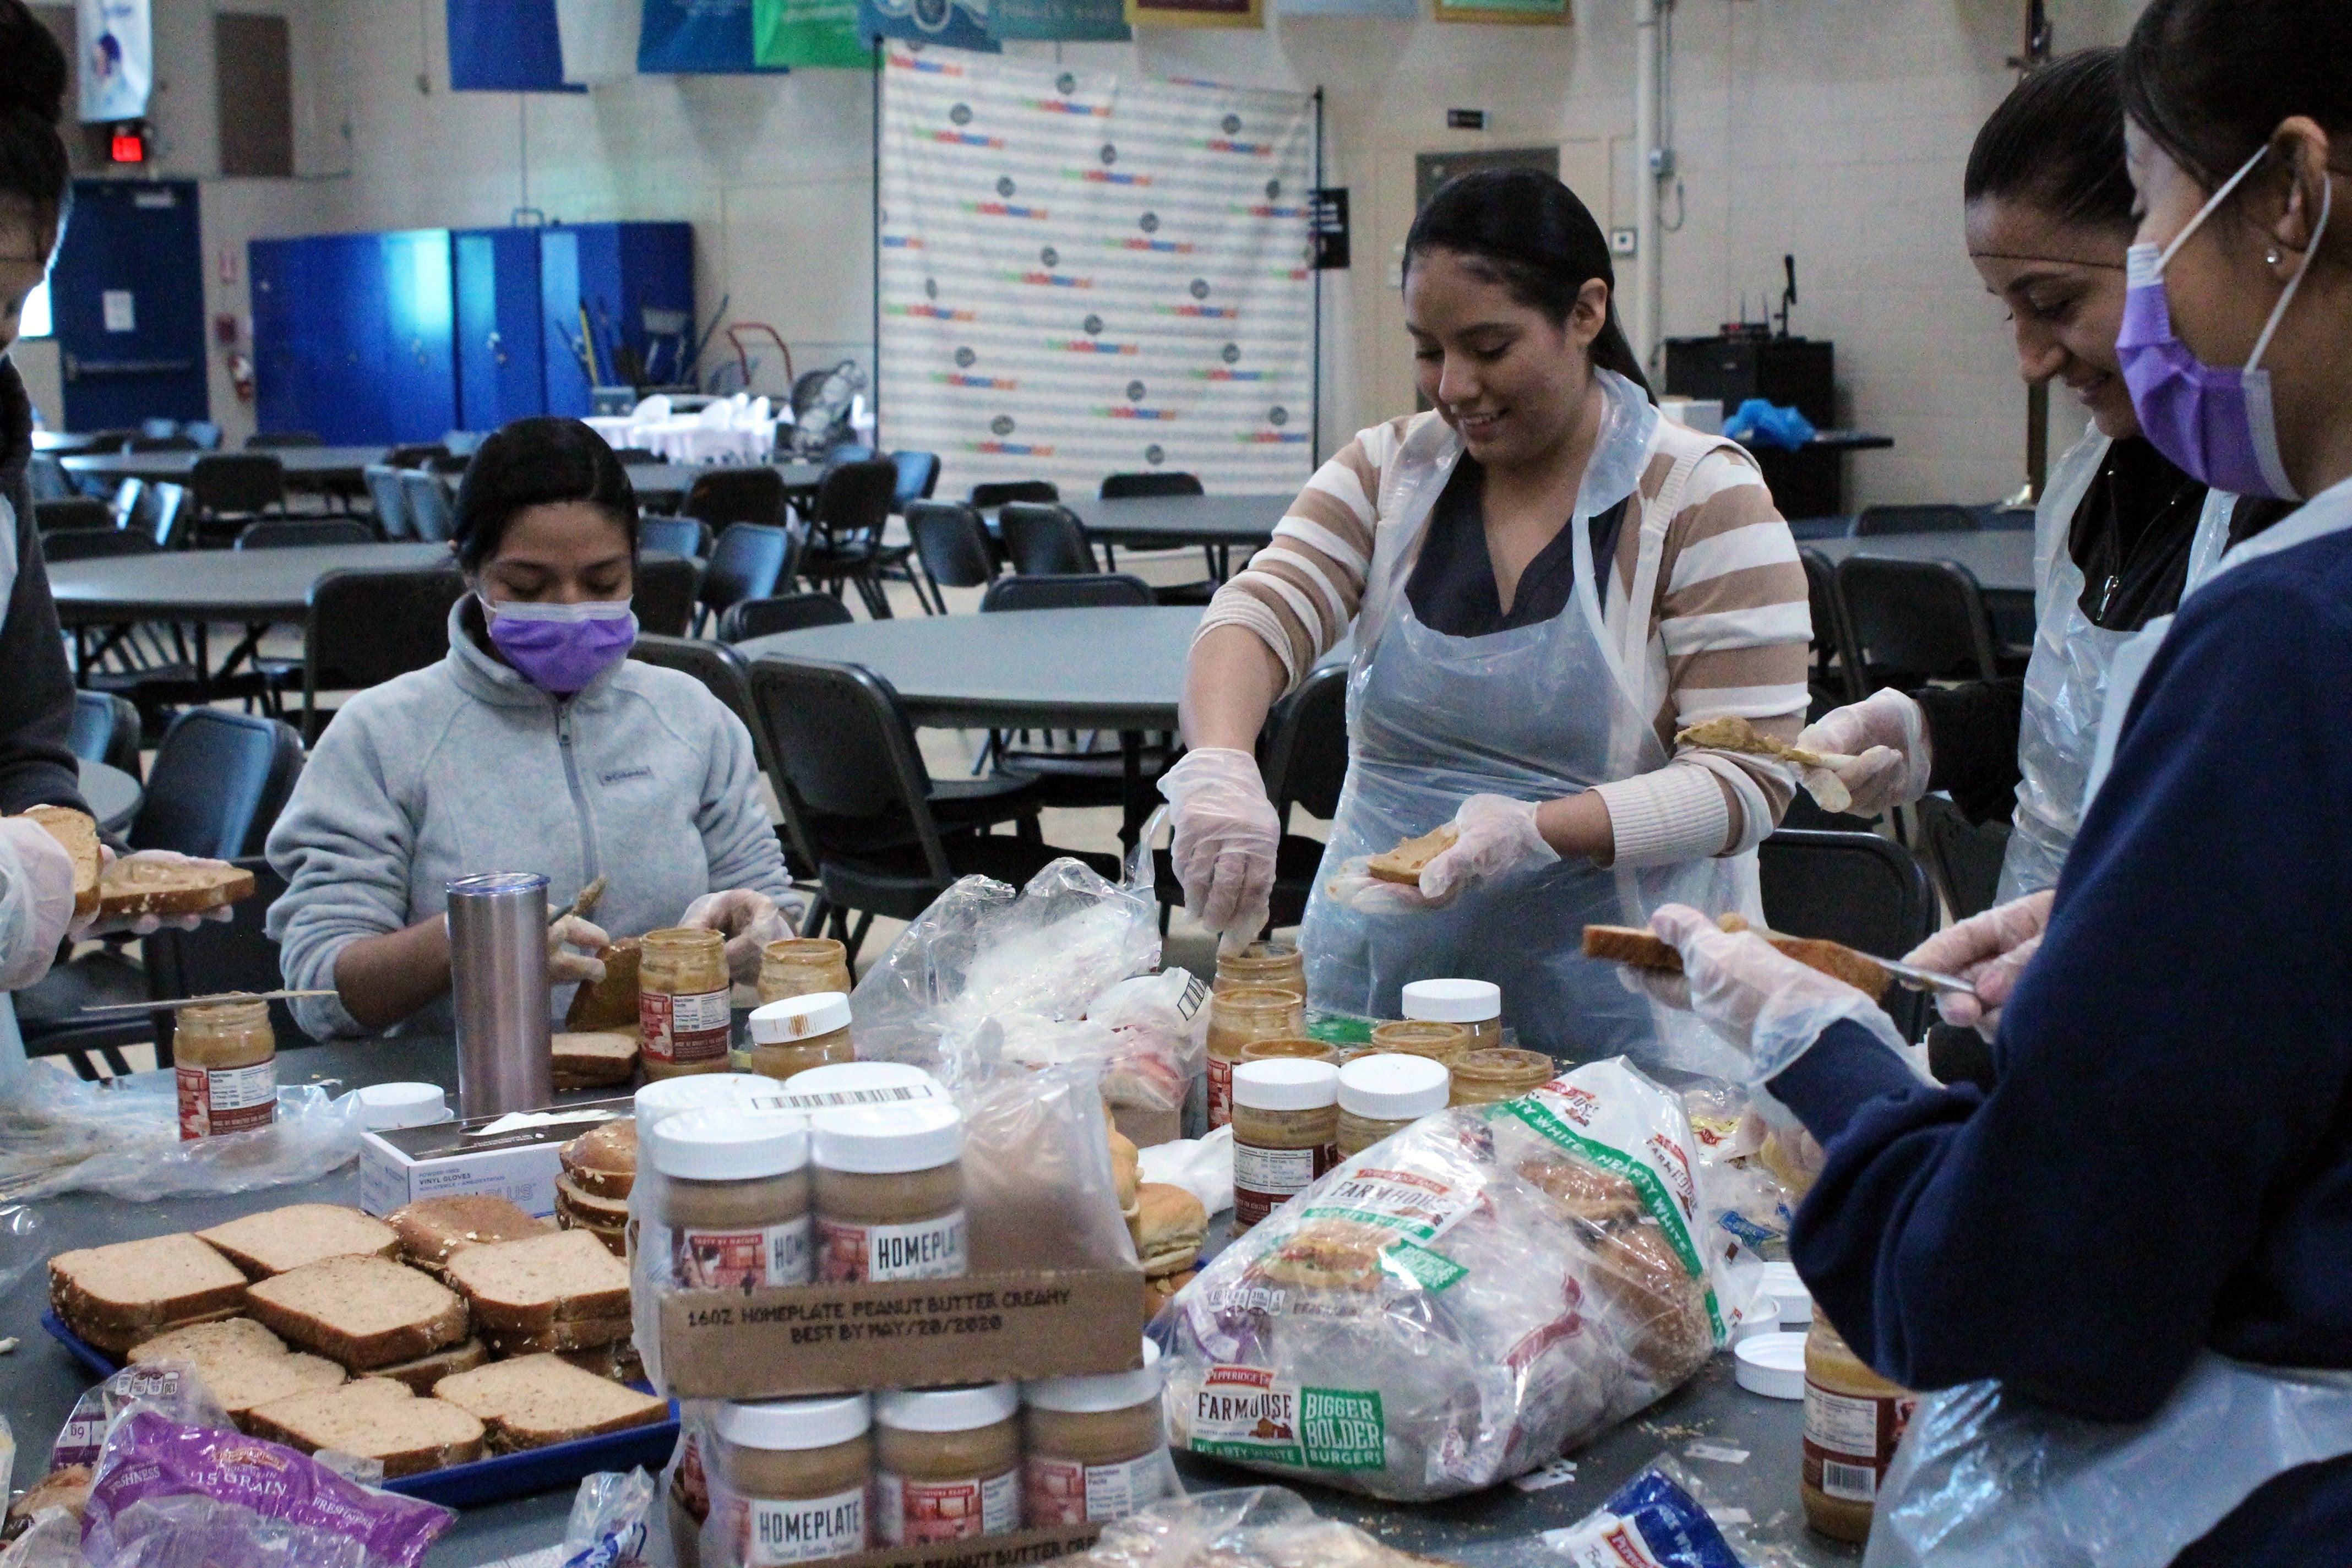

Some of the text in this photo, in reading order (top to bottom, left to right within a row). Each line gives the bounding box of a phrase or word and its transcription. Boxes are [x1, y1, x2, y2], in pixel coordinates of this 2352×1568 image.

[419, 1172, 472, 1185] VINYL GLOVES
[742, 1302, 845, 1323] HOMEPLATE
[852, 1297, 923, 1317] PEANUT
[927, 1292, 998, 1314] BUTTER
[1002, 1288, 1071, 1309] CREAMY
[790, 1324, 835, 1344] BEST
[839, 1322, 864, 1342] BY
[1305, 1392, 1375, 1420] BIGGER
[1305, 1419, 1380, 1450] BOLDER
[1309, 1449, 1381, 1465] BURGERS
[197, 1472, 287, 1496] 15 GRAIN
[759, 1500, 860, 1543] HOMEPLATE
[994, 1542, 1061, 1566] BUTTER
